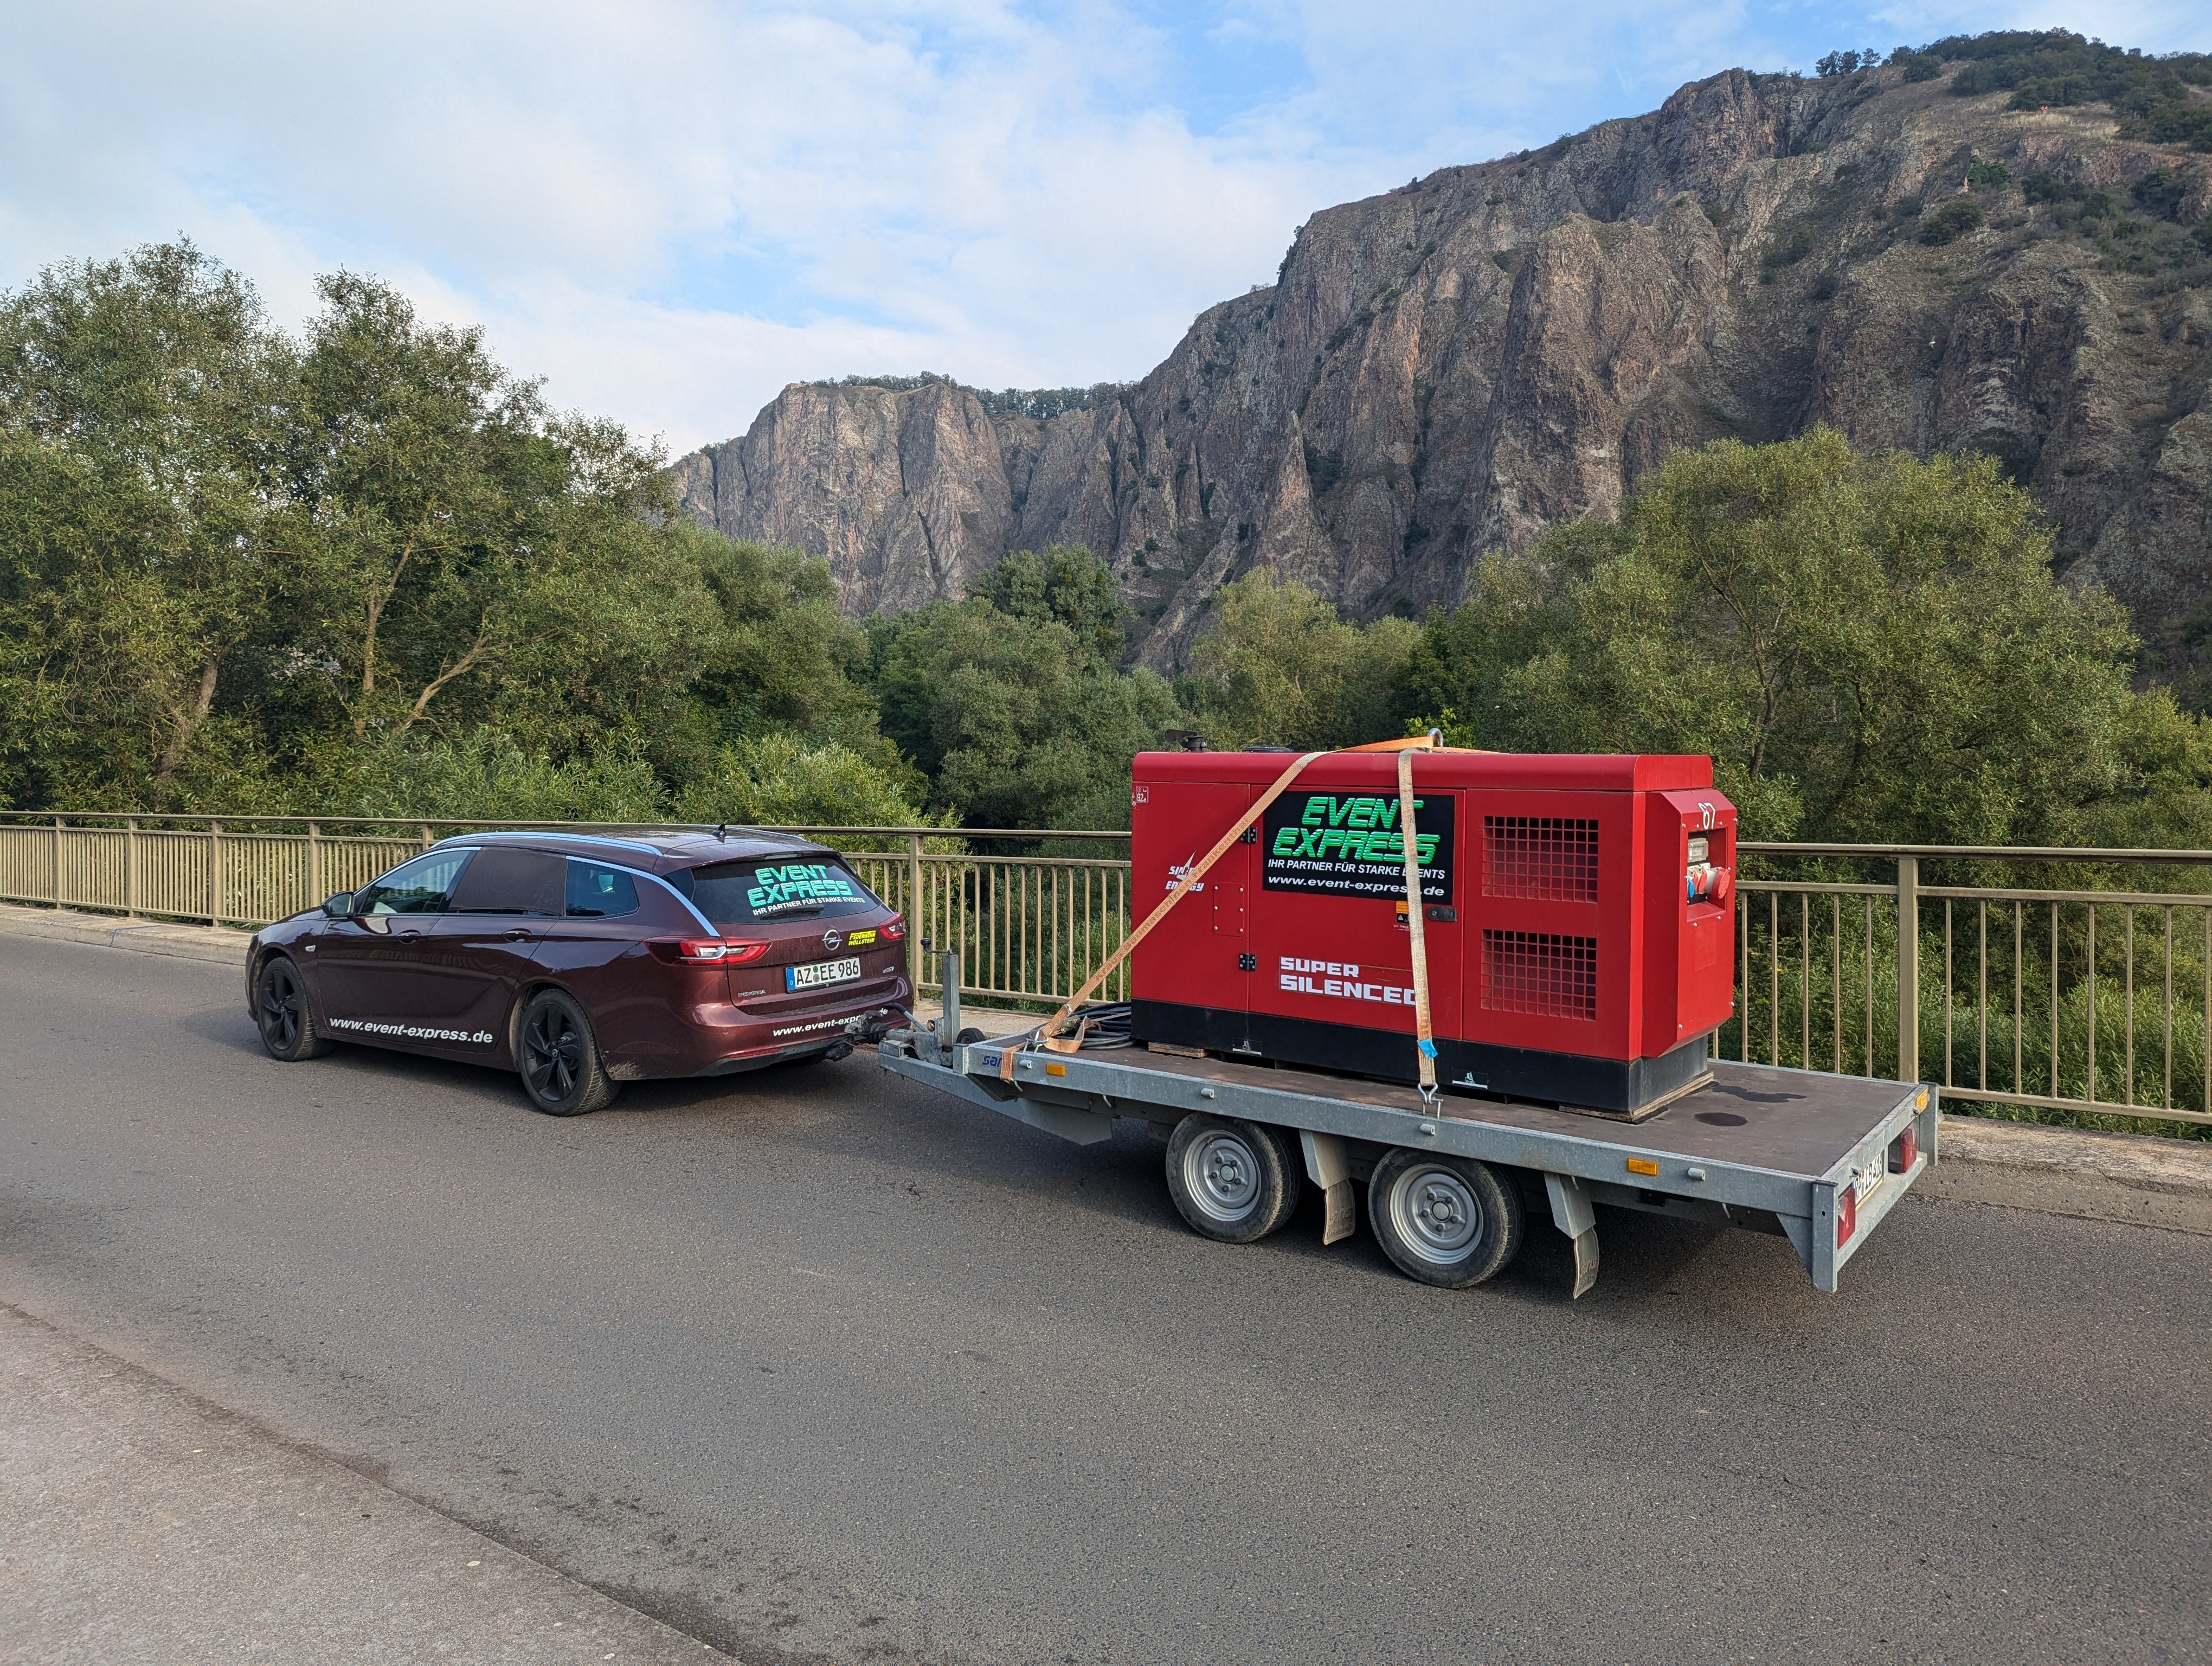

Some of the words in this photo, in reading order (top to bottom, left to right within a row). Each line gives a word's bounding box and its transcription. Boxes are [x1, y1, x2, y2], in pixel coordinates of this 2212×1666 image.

[1698, 803, 1715, 830] 67
[1273, 827, 1441, 864] EXPRESS
[755, 865, 828, 885] EVENT
[1268, 858, 1284, 868] IHR
[1287, 860, 1333, 872] PARTNER
[1335, 862, 1356, 873] FÜR
[1358, 864, 1400, 876] STARKE
[748, 880, 853, 907] EXPRESS
[1268, 876, 1444, 896] www.event-expres.de
[753, 907, 767, 916] IHR
[769, 900, 801, 912] PARTNER
[802, 898, 816, 907] FÜR
[796, 967, 813, 985] AZ
[820, 964, 837, 981] EE
[838, 960, 859, 978] 986
[1281, 957, 1359, 978] SUPER
[737, 989, 766, 997] INSIGNIA
[330, 1018, 493, 1043] www.event-express.de
